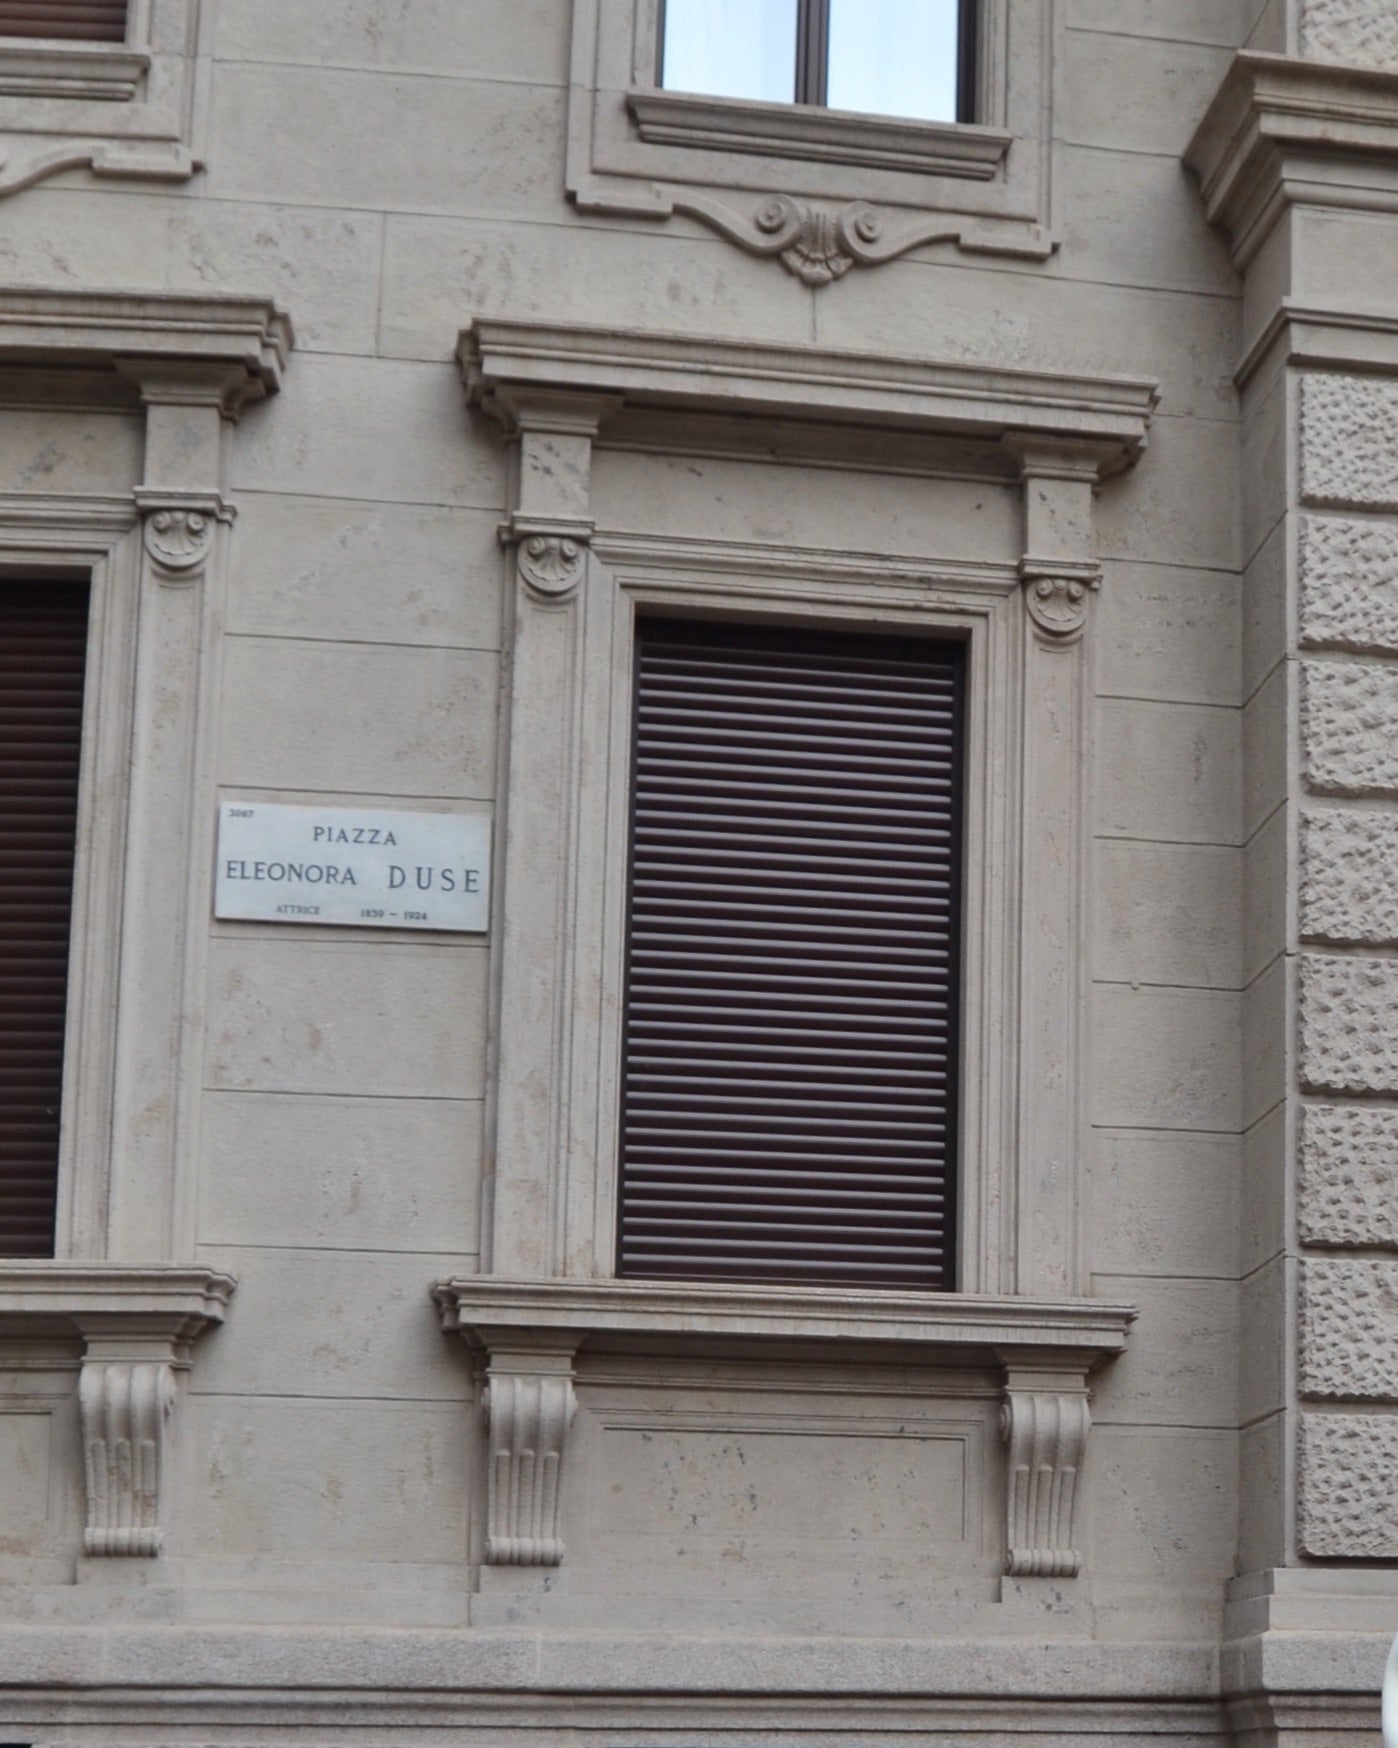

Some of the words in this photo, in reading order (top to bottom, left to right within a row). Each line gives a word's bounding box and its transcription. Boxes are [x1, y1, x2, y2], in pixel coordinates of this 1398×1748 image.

[313, 826, 397, 846] PIAZZA
[226, 860, 357, 886] ELEONORA
[388, 865, 481, 893] DUSE
[275, 904, 321, 915] ATTRICE
[404, 910, 428, 920] 1924
